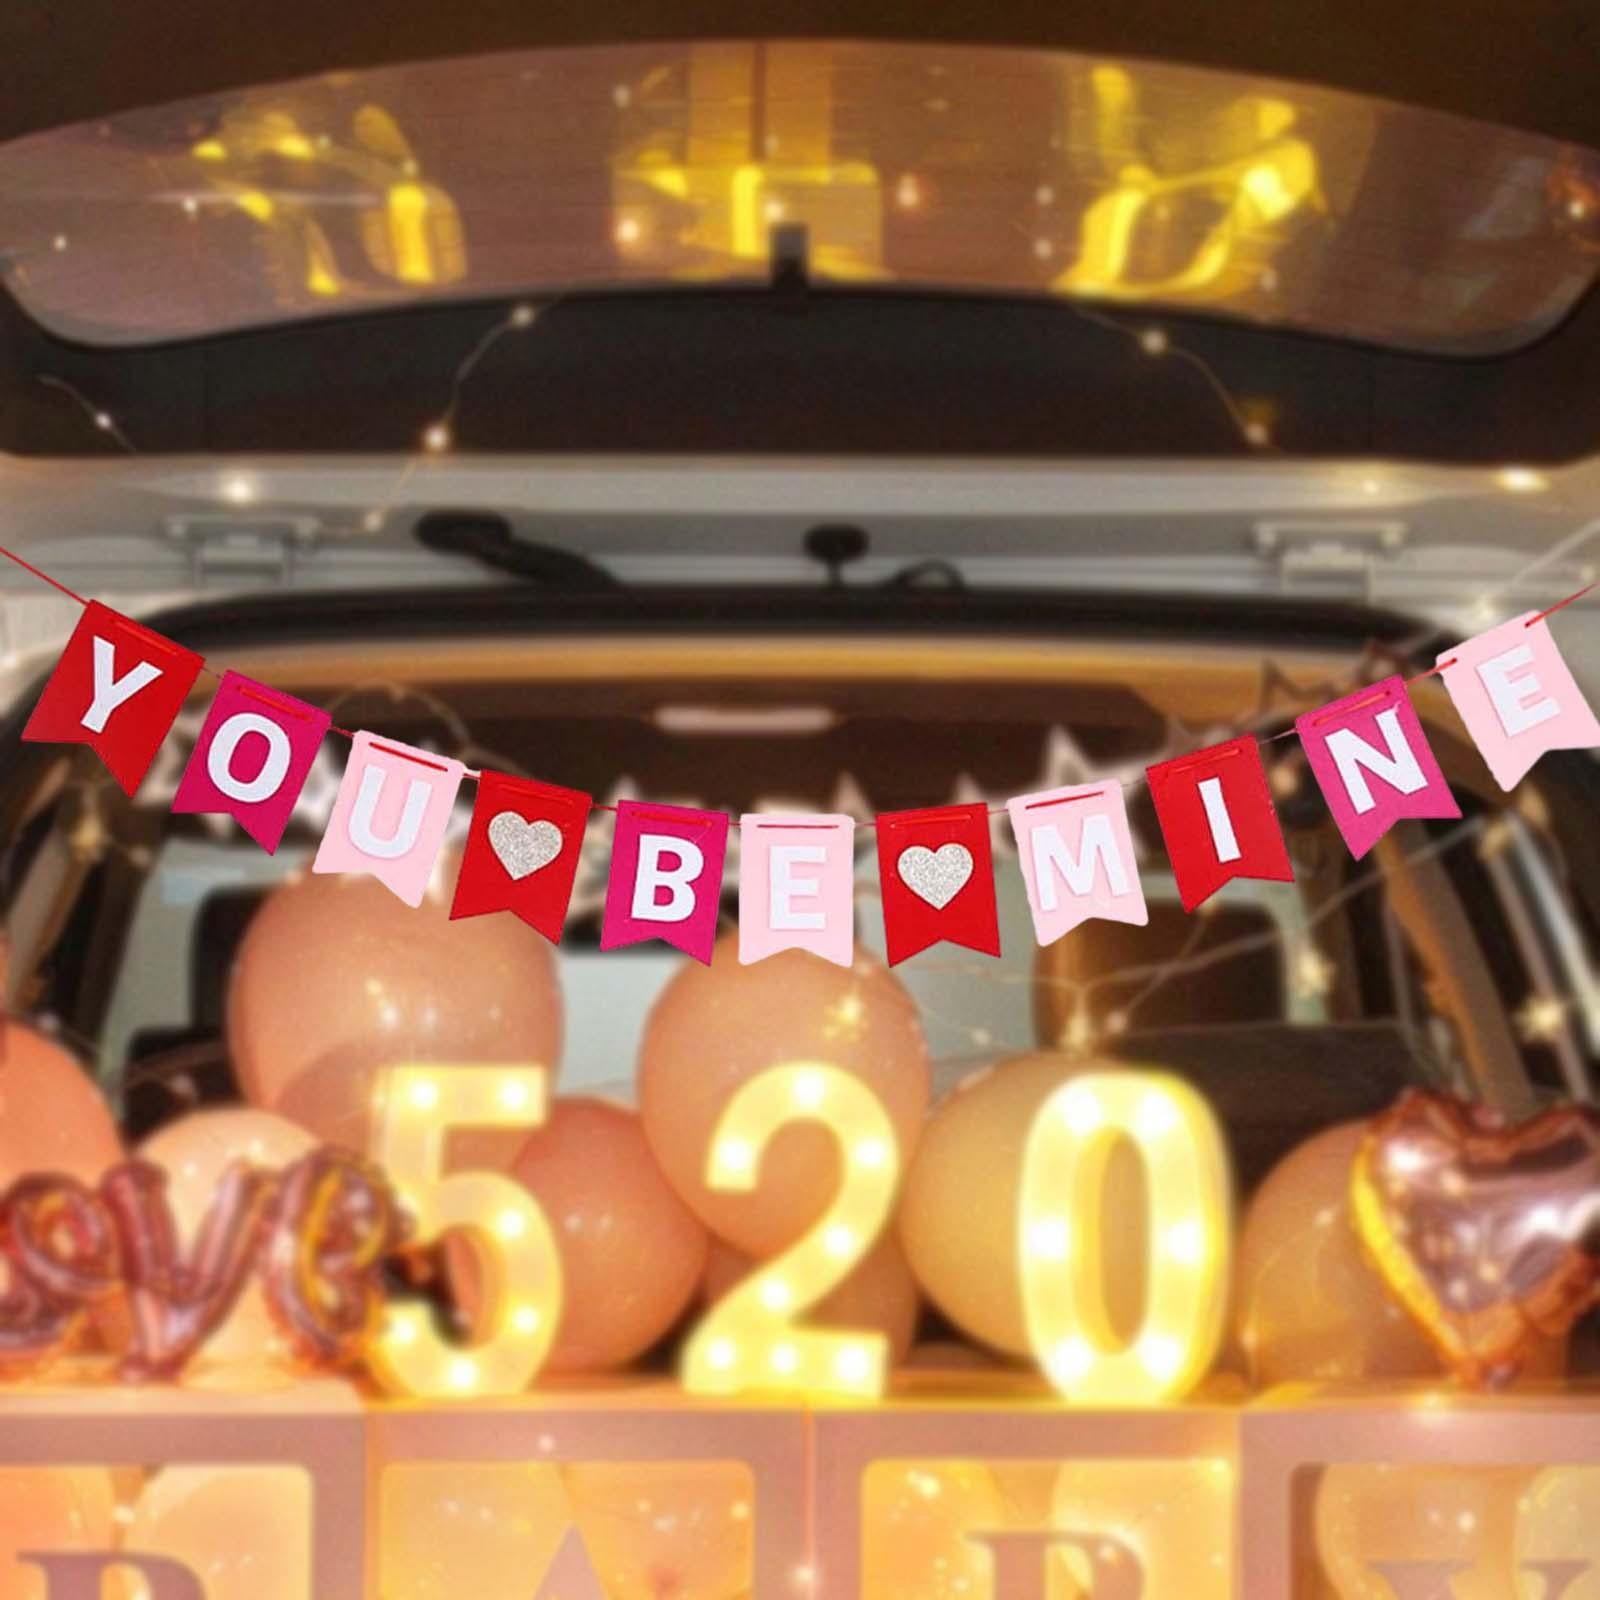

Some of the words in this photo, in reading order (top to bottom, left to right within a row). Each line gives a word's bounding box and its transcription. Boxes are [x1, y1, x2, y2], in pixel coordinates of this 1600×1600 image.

[80, 635, 433, 858] YOU
[630, 833, 826, 930] BE
[1031, 645, 1562, 912] MINE
